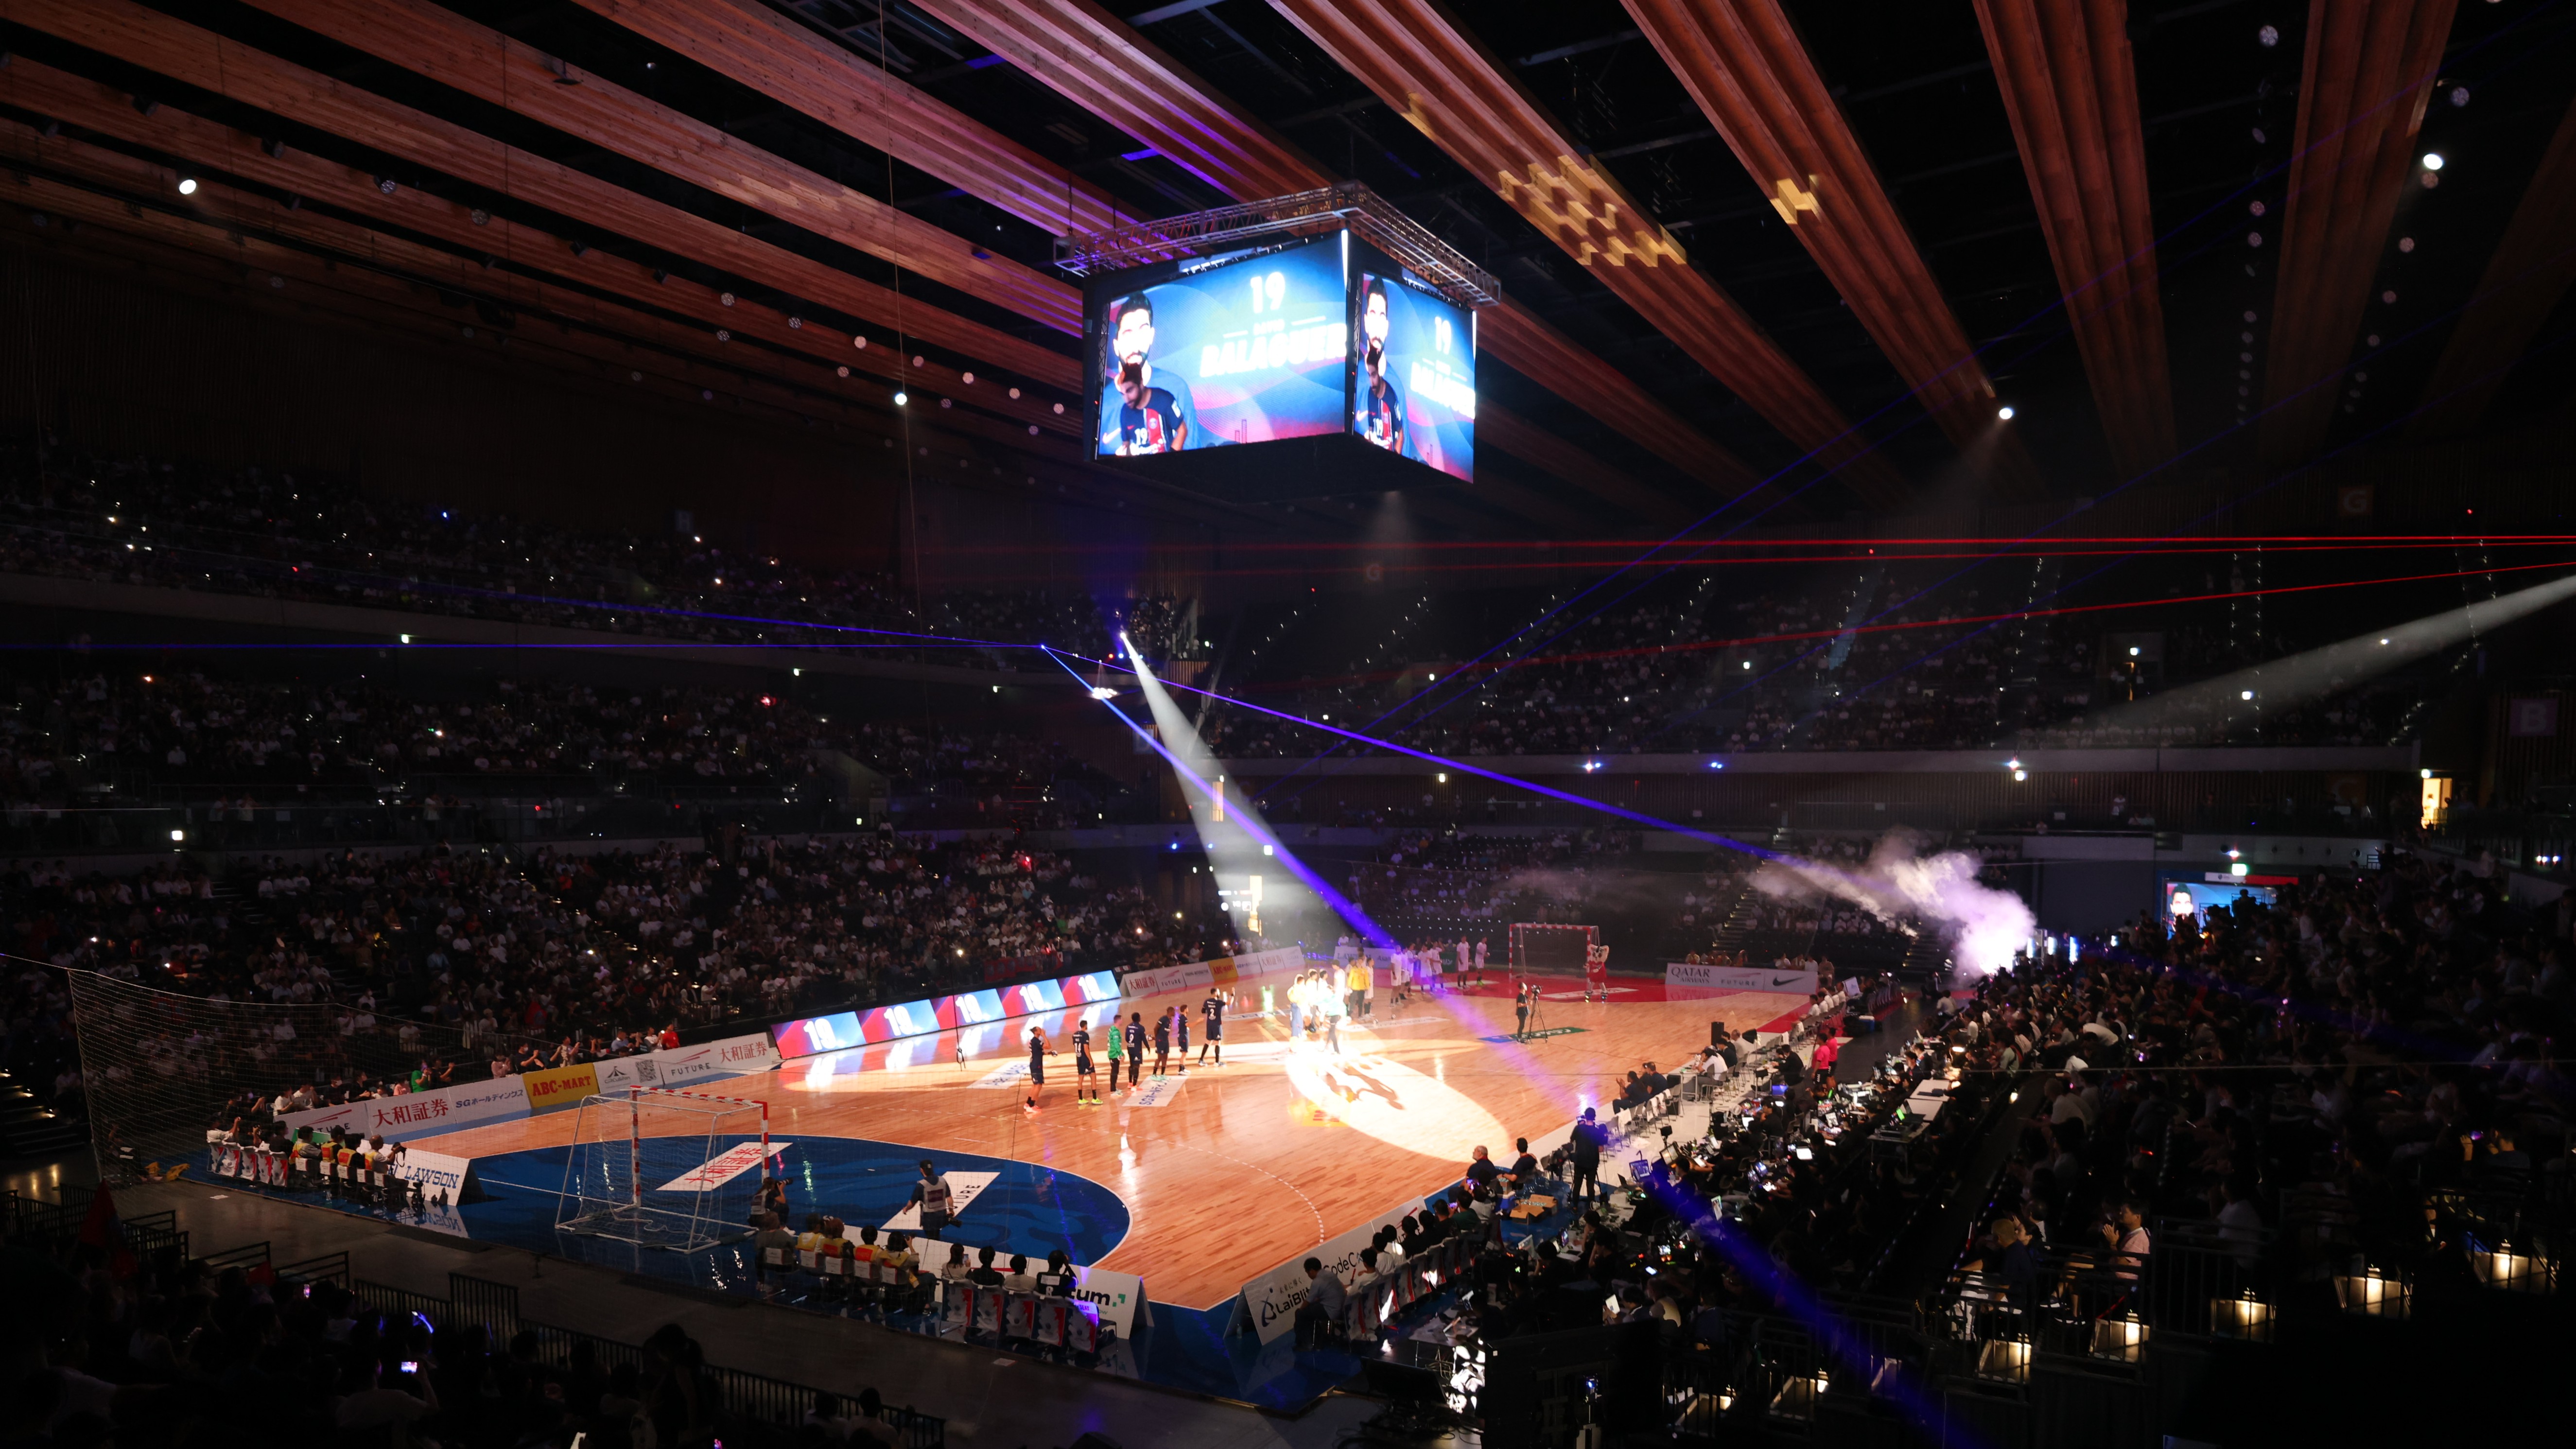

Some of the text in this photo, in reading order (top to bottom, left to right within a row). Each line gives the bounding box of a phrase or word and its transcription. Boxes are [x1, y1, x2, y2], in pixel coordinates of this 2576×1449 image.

[1251, 272, 1286, 314] 19
[1435, 316, 1452, 355] 19
[1134, 428, 1148, 445] 19
[2343, 489, 2367, 513] G
[1366, 563, 1381, 581] G
[2520, 702, 2546, 733] B
[1129, 976, 1155, 991] 大和証券
[1161, 978, 1182, 987] FUTURE
[1671, 966, 1710, 978] QATAR
[1019, 984, 1046, 1012] 19
[1078, 975, 1102, 1001] 19
[884, 1005, 917, 1036] 19
[956, 994, 985, 1023] 19
[803, 1018, 837, 1051] 19
[720, 1042, 768, 1064] 大和証券
[1074, 1043, 1081, 1053] 14
[671, 1063, 711, 1076] FUTURE
[455, 1089, 523, 1108] SGホールディングス
[532, 1076, 591, 1097] ABC-MART
[373, 1099, 449, 1128] 大和証券
[404, 1166, 459, 1189] LAWSON
[950, 1185, 981, 1209] TURE
[1275, 1287, 1310, 1313] LaiBlit
